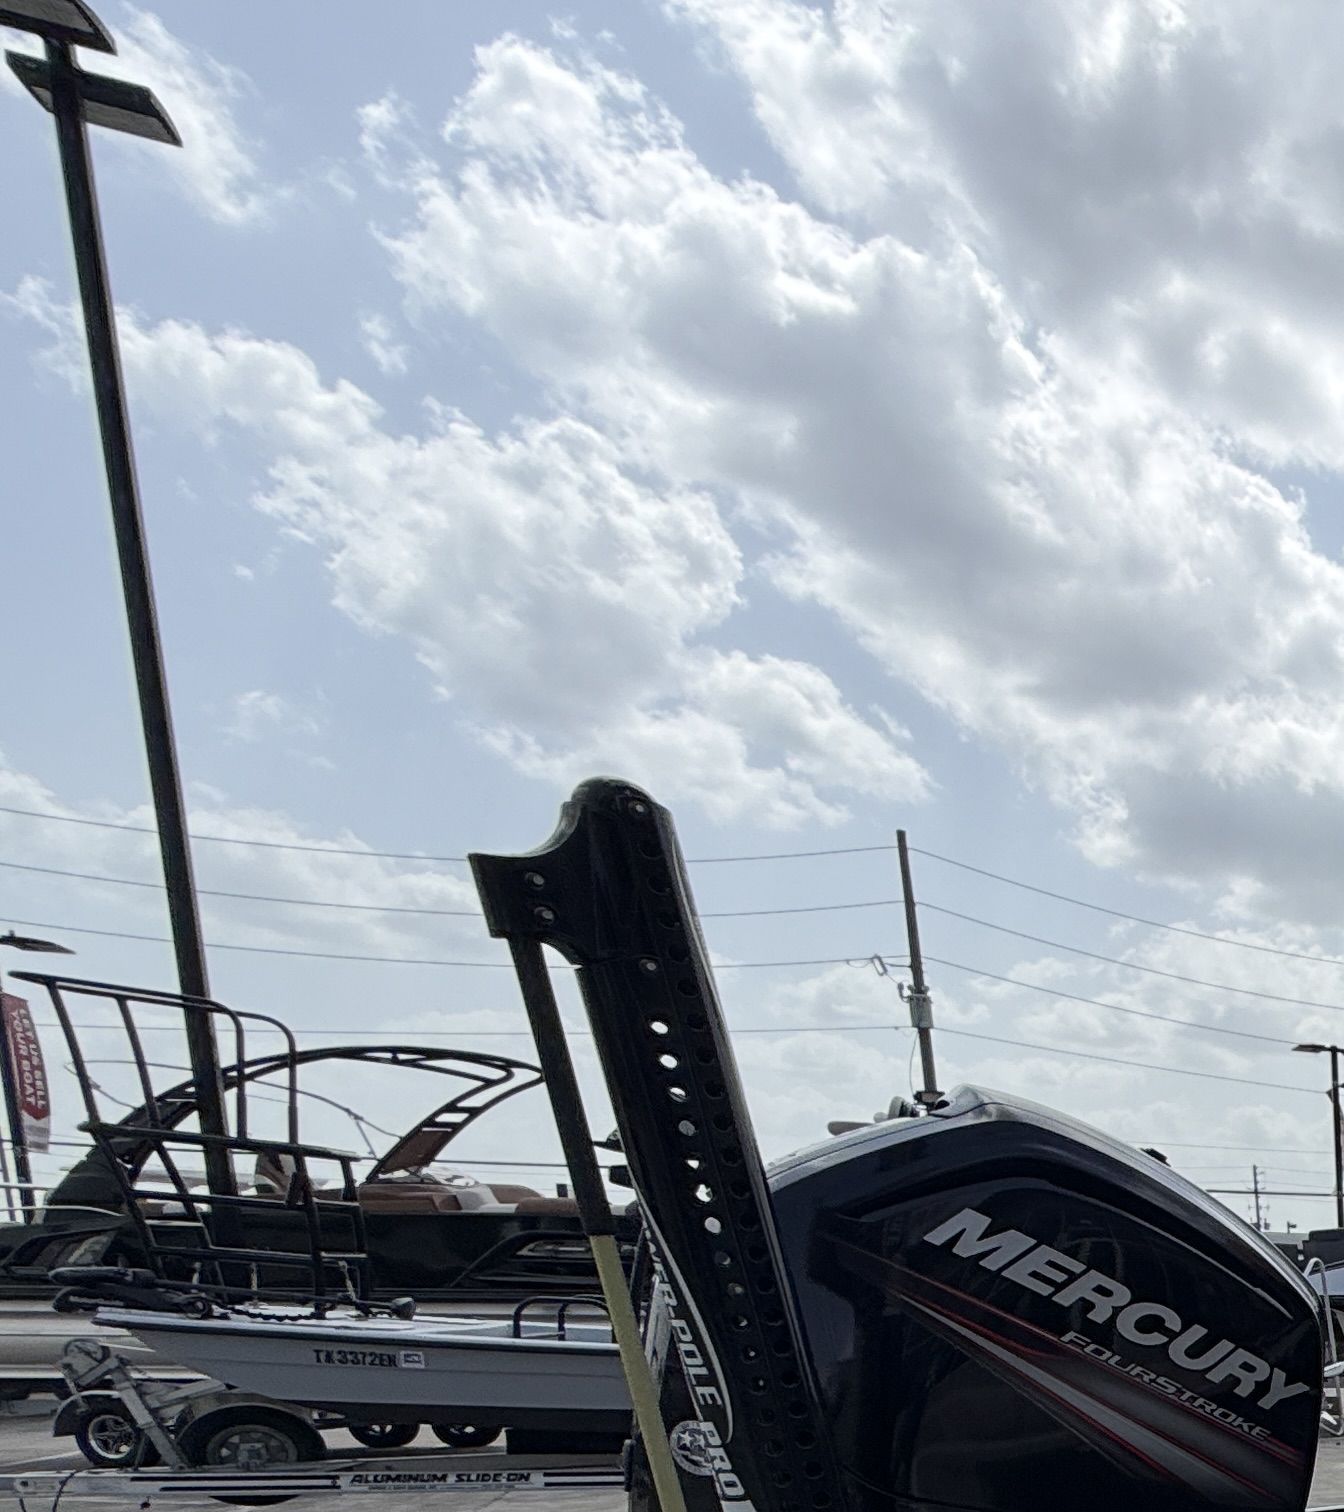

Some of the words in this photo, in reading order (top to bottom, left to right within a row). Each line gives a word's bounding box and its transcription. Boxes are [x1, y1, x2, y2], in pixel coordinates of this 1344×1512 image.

[11, 1009, 29, 1056] YOUR
[21, 1059, 36, 1106] BOAT
[19, 1008, 34, 1041] LET
[34, 1069, 46, 1109] SELL
[923, 1207, 1311, 1411] MERCURY
[1060, 1330, 1272, 1440] FOURSTROKE
[350, 1472, 449, 1484] ALUMINUM
[454, 1472, 532, 1483] SLIDE-ON
